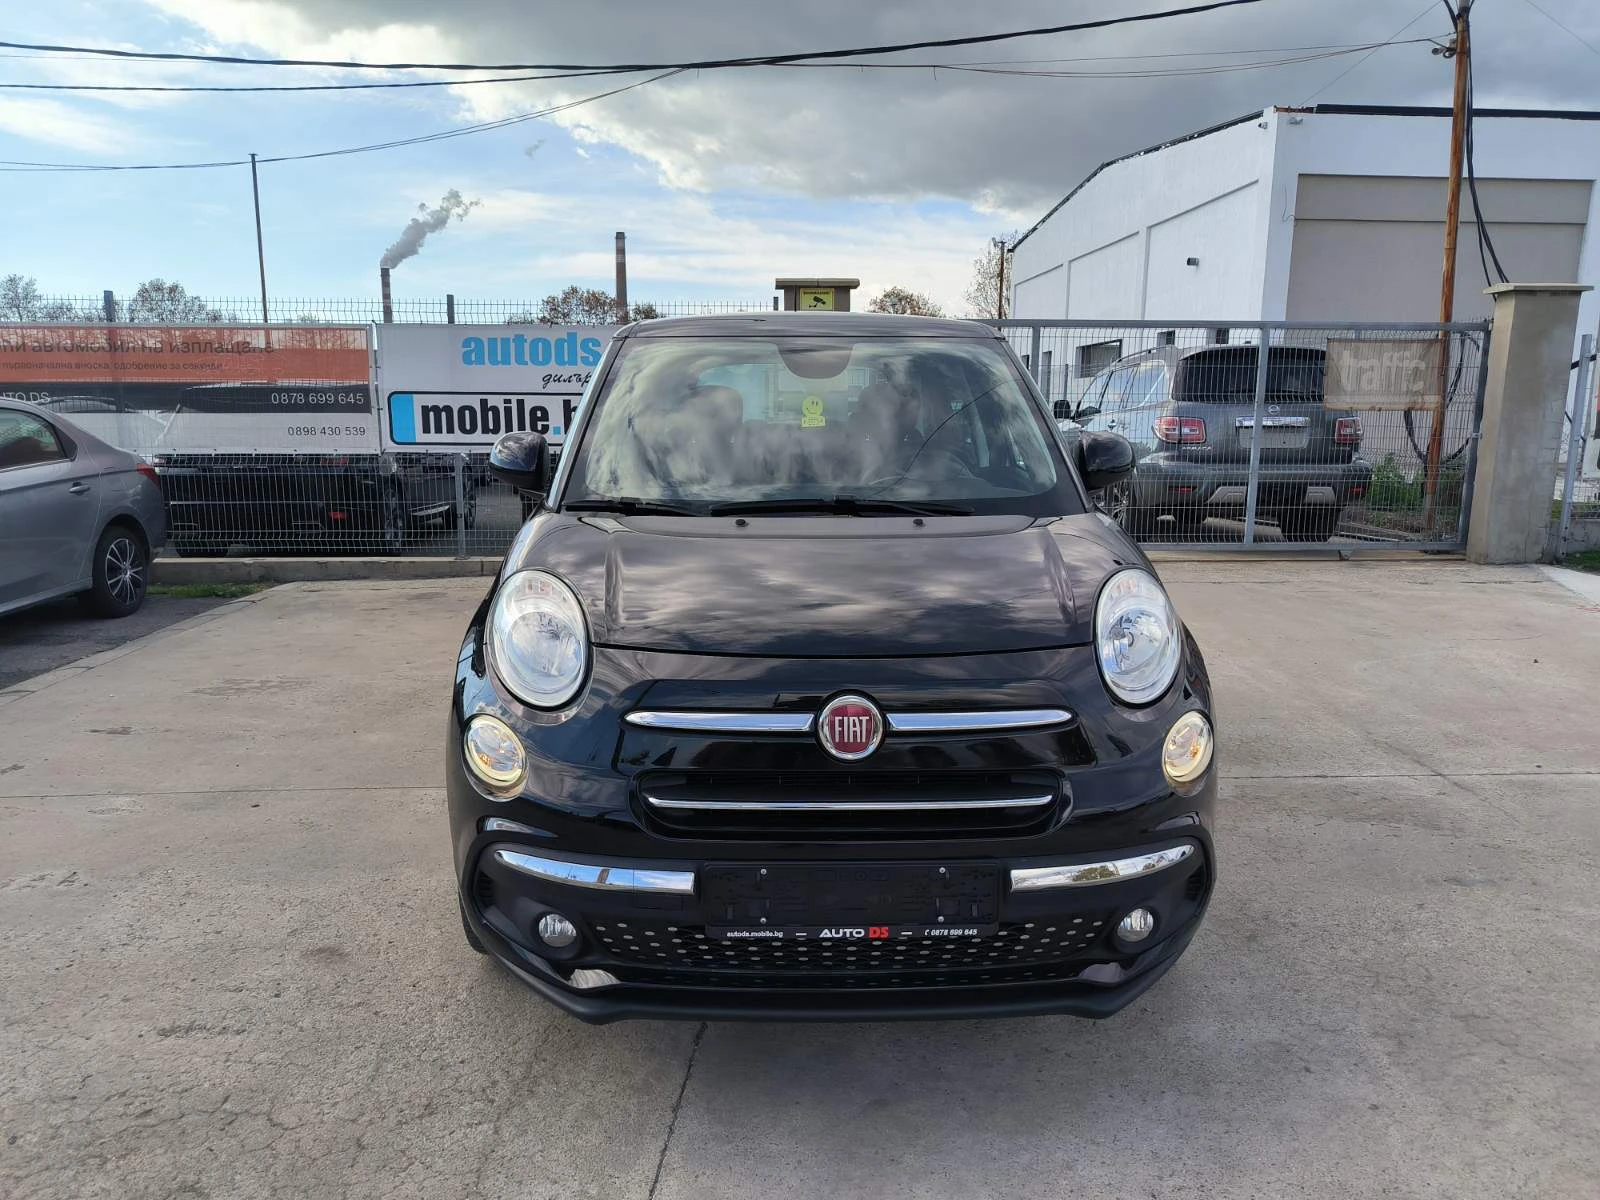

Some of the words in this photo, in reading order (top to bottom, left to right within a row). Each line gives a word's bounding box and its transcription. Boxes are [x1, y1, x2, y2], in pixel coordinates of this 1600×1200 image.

[32, 339, 136, 353] автомобил
[142, 341, 163, 353] на
[461, 332, 602, 366] autods
[169, 362, 180, 370] за
[1340, 350, 1425, 393] traffic
[30, 391, 50, 403] DS
[271, 392, 305, 404] 0878
[309, 392, 334, 404] 699
[338, 392, 364, 404] 645
[287, 426, 317, 436] 0898
[319, 426, 341, 436] 430
[345, 426, 366, 436] 539
[834, 716, 869, 743] FIAT
[819, 928, 865, 938] AUTO
[868, 926, 889, 938] DS
